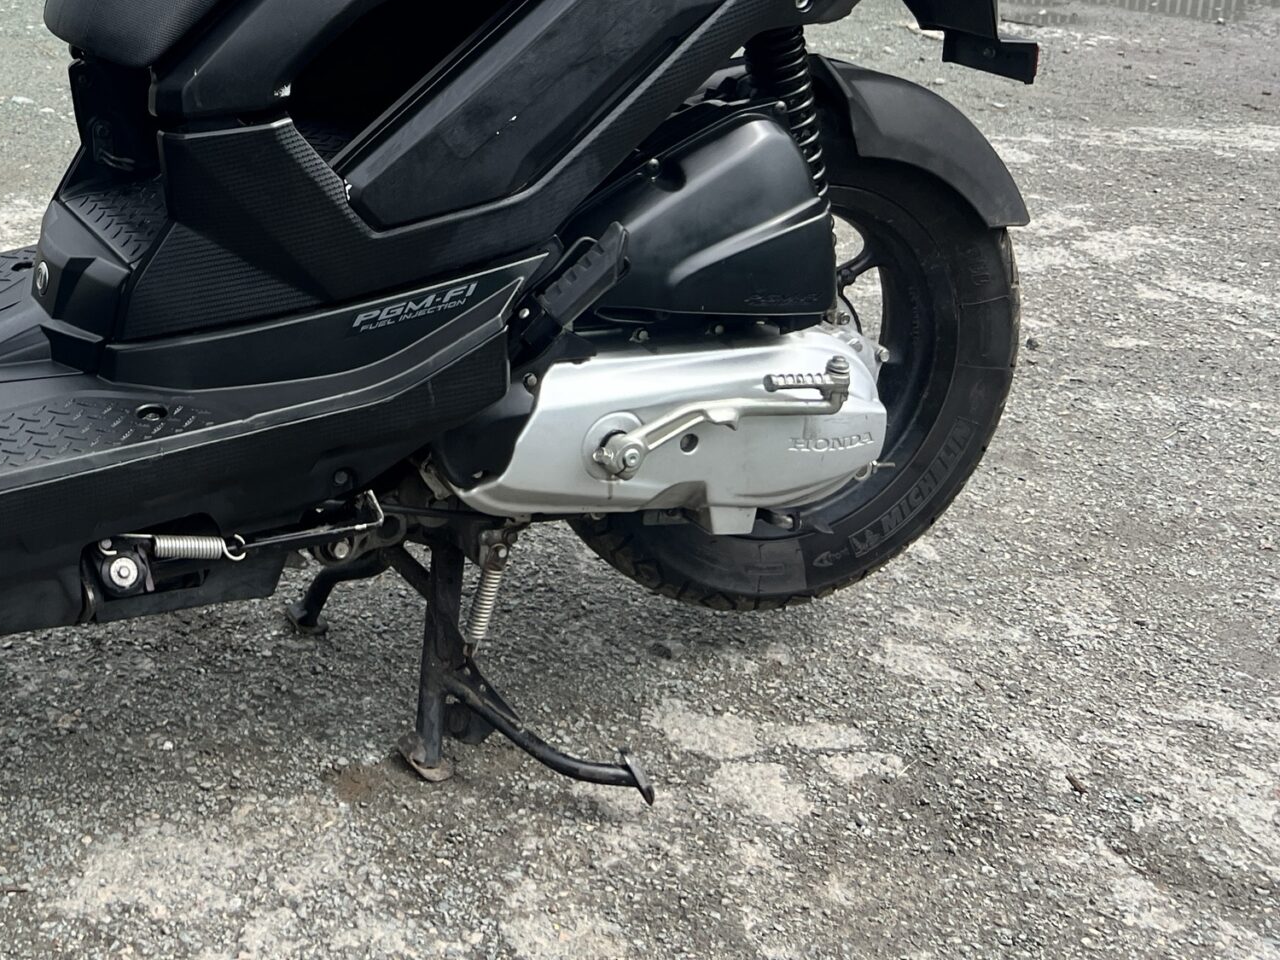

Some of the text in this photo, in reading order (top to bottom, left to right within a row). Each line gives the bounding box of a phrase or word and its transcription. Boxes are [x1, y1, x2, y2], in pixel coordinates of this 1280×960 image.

[360, 298, 466, 333] FUEL INJECTION
[787, 431, 875, 452] HONDA
